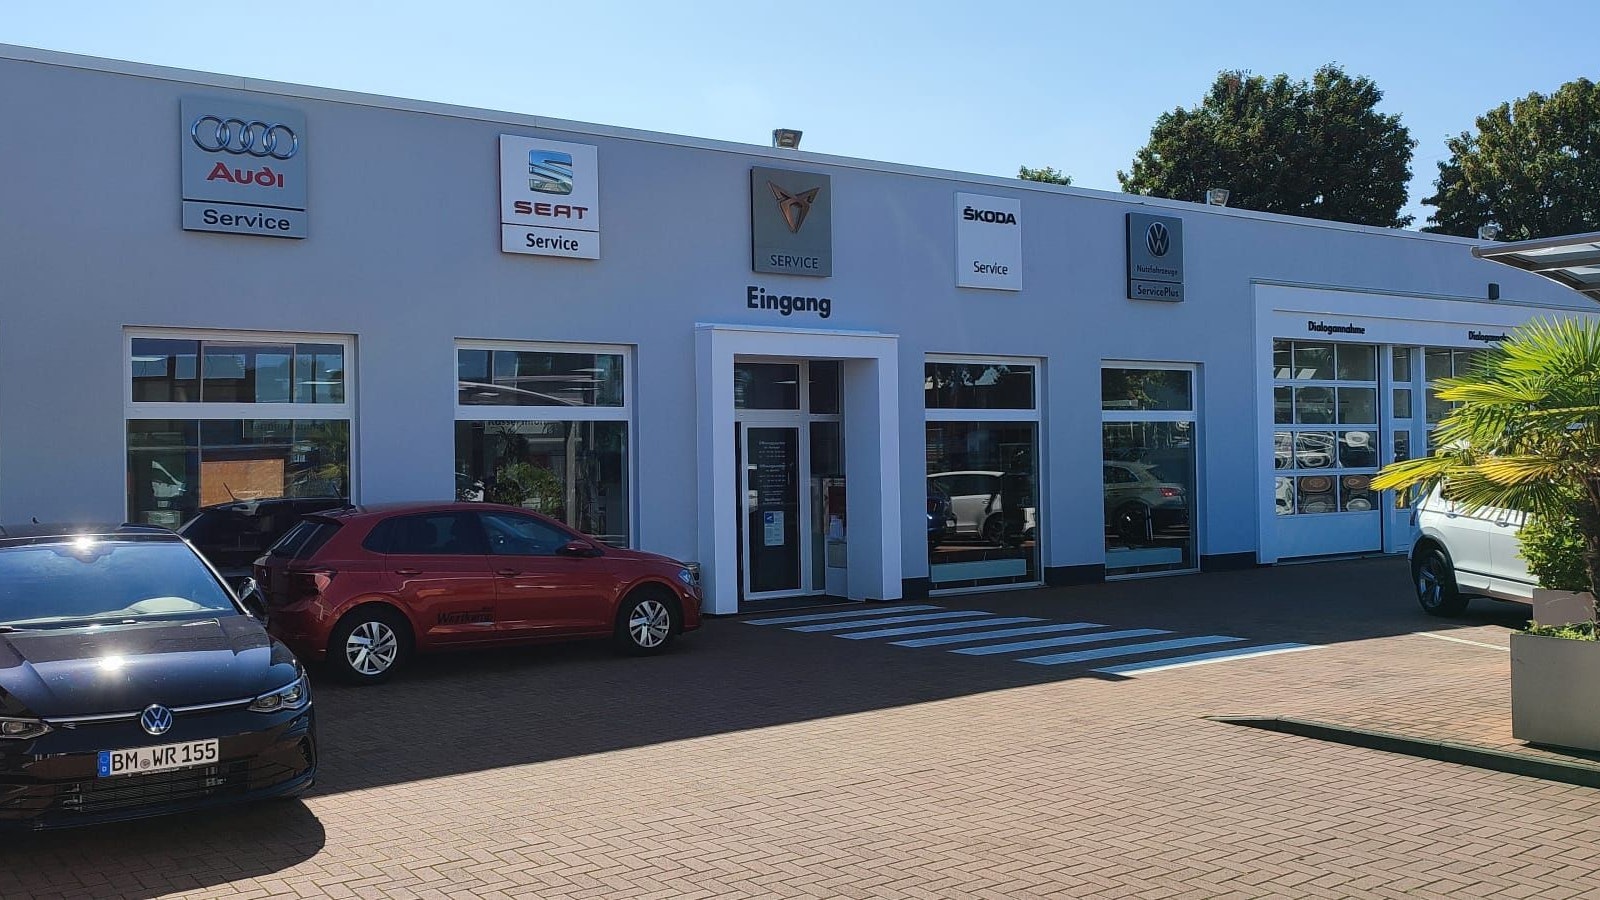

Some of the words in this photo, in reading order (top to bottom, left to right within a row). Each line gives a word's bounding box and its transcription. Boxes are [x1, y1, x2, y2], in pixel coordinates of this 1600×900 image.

[206, 162, 285, 188] Audi
[514, 200, 588, 219] SEAT
[963, 206, 1016, 225] ŠKODA
[203, 209, 290, 231] Service
[526, 233, 579, 252] Service
[770, 254, 819, 270] SERVICE
[974, 261, 1008, 276] Service
[1138, 285, 1179, 297] ServicePlus
[747, 286, 832, 318] Eingang
[1308, 321, 1365, 335] Dialogannahme
[113, 753, 138, 772] BM
[153, 747, 176, 767] WR
[181, 742, 216, 763] 155
